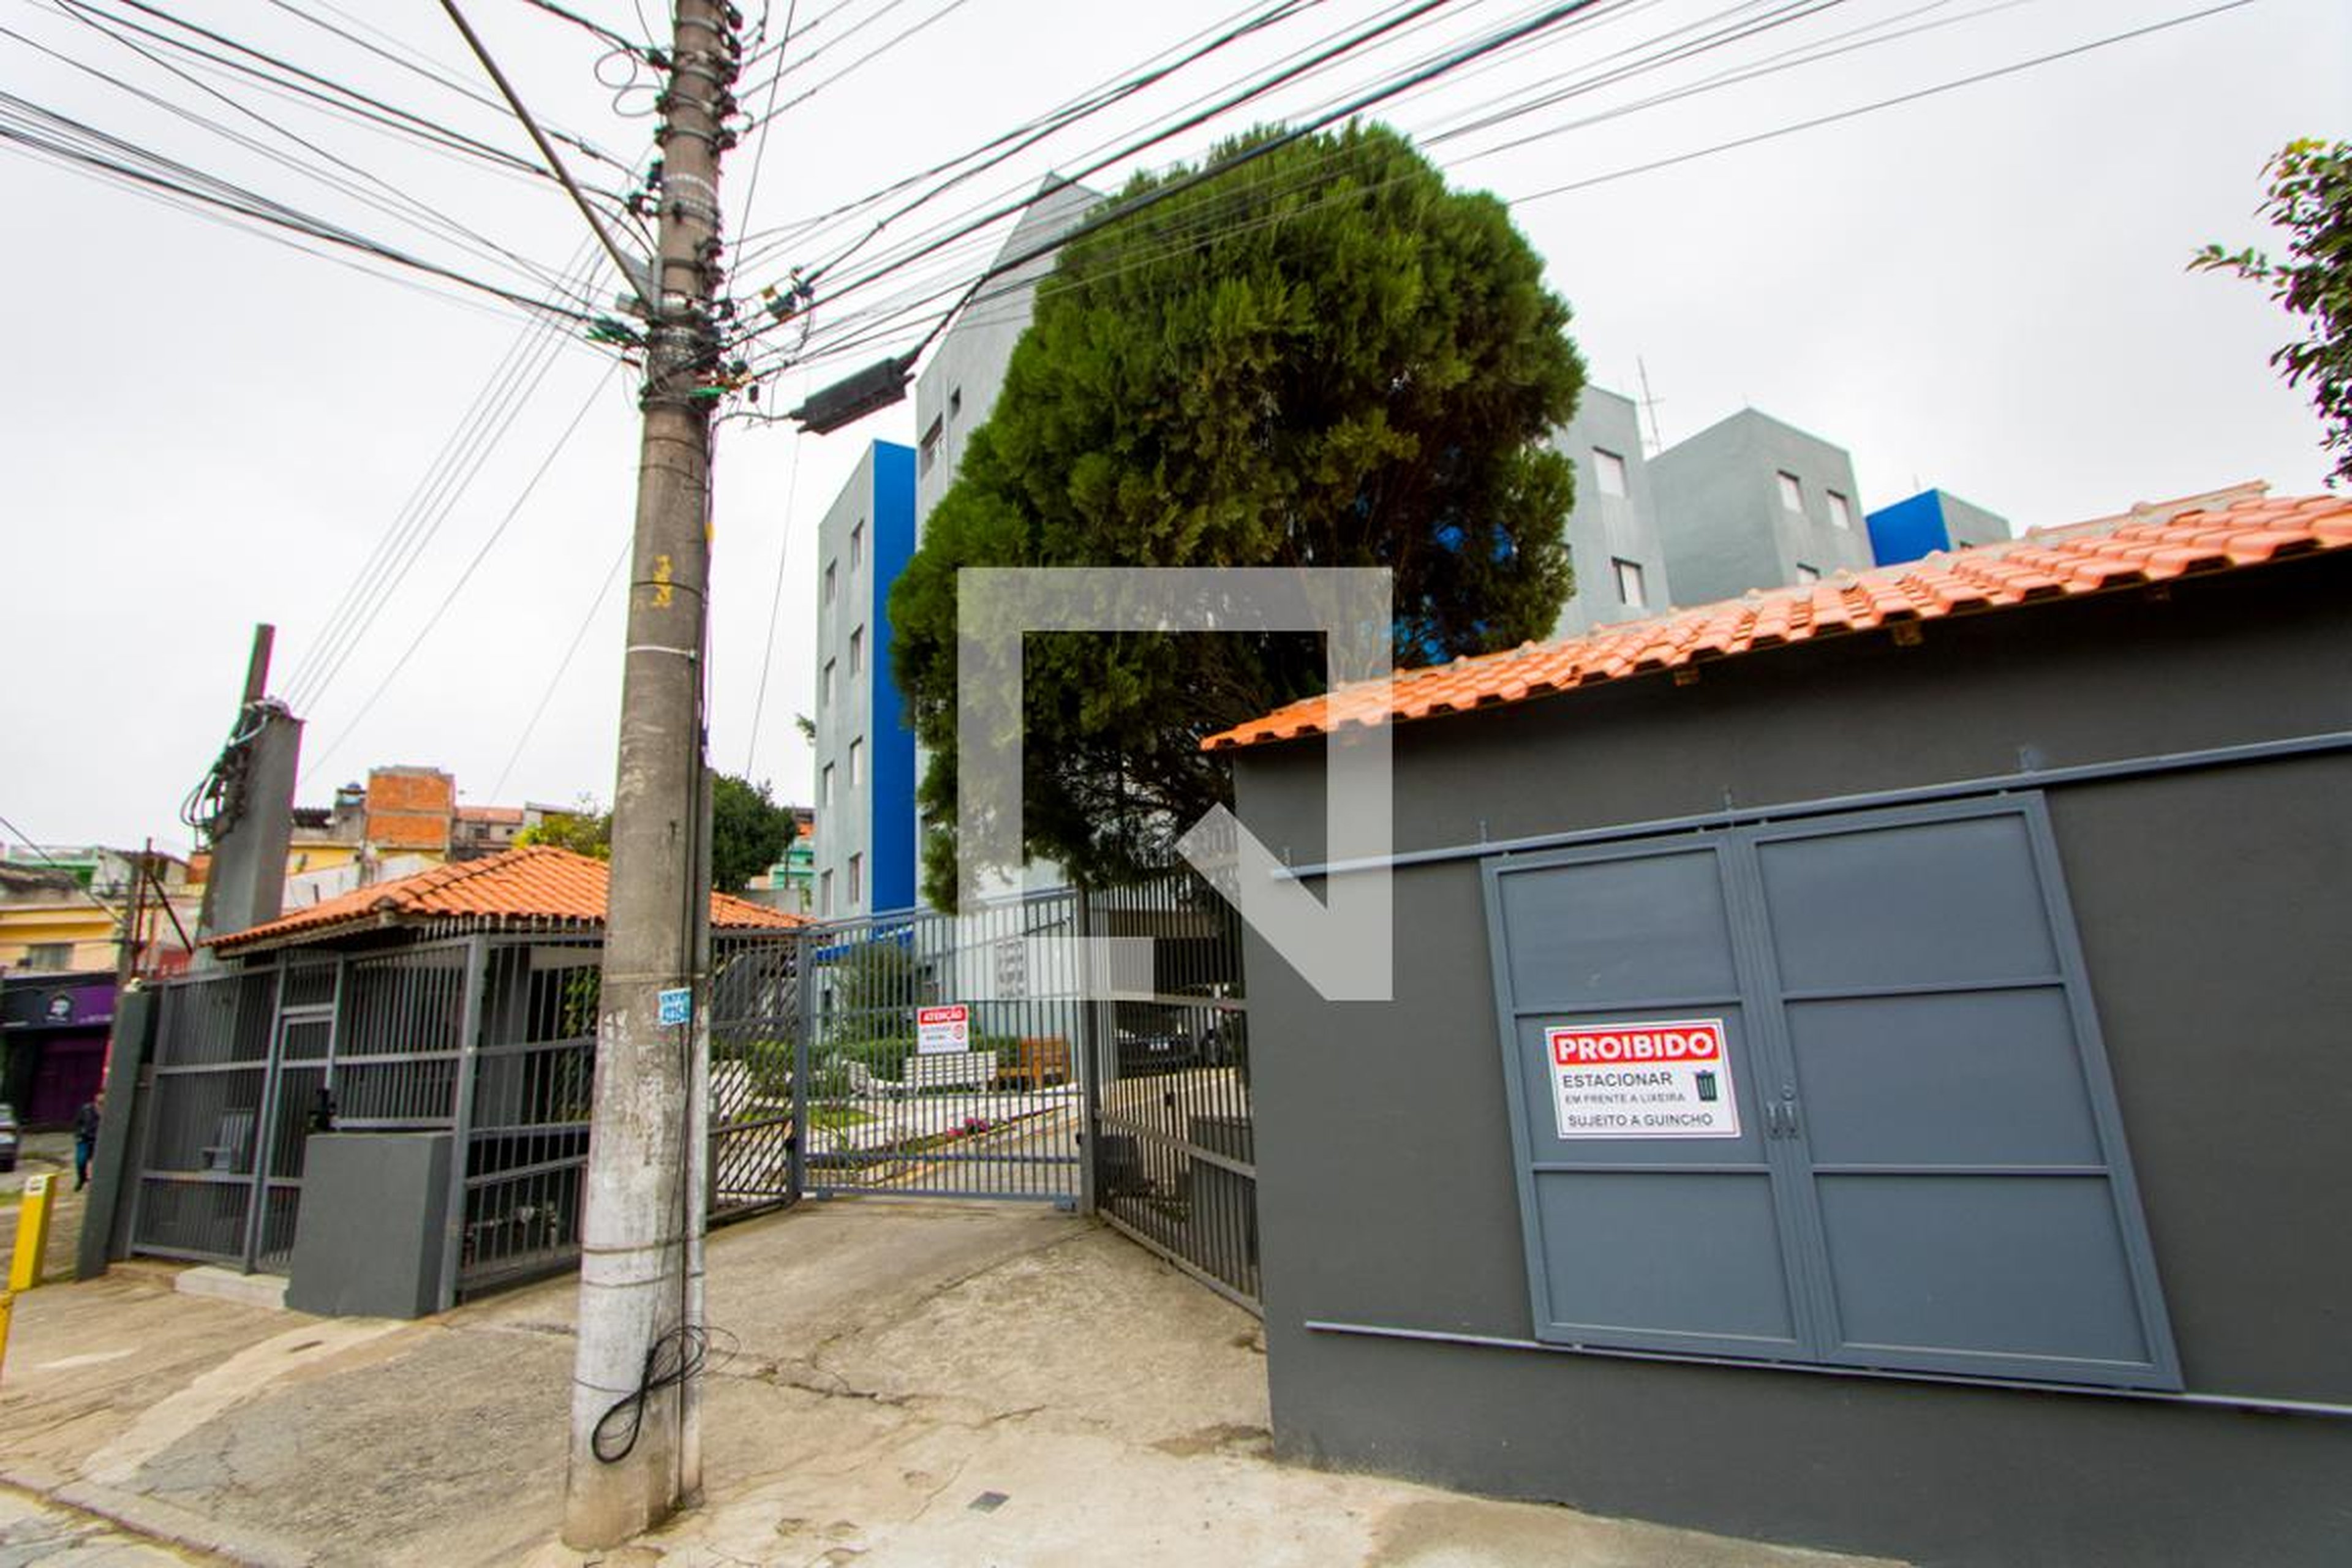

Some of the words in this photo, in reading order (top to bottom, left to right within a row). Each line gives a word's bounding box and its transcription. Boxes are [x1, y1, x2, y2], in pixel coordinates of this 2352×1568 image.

[1556, 1032, 1714, 1060] PROIBIDO
[1563, 1072, 1672, 1088] ESTACIONAR
[1566, 1094, 1581, 1104] EM
[1584, 1093, 1626, 1103] FRENTE
[1630, 1093, 1639, 1102] A
[1642, 1092, 1685, 1102] LIXEIRA
[1568, 1115, 1627, 1127] SUJEITO
[1631, 1115, 1641, 1126] A
[1643, 1112, 1713, 1126] GUINCHO
